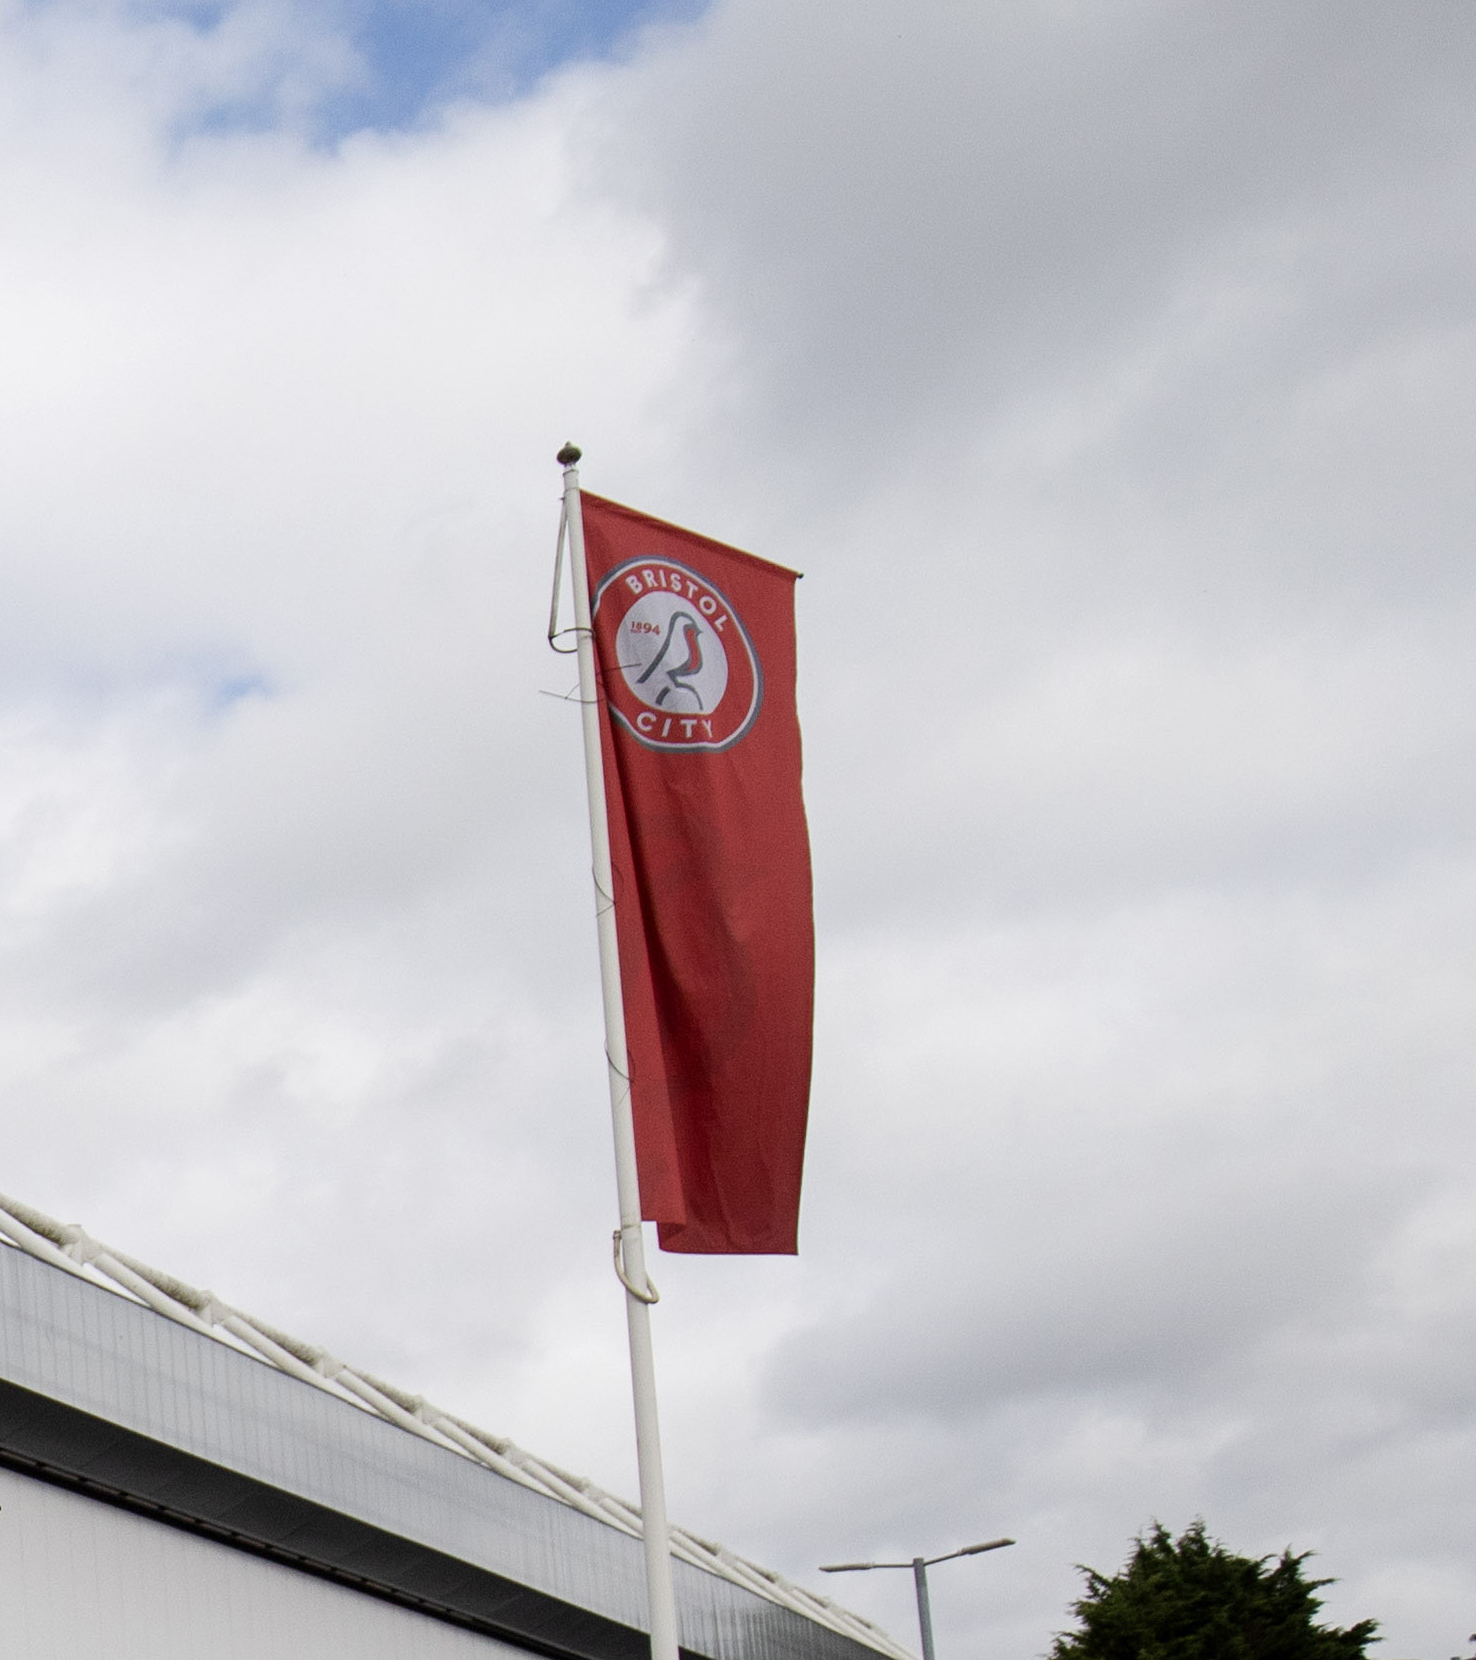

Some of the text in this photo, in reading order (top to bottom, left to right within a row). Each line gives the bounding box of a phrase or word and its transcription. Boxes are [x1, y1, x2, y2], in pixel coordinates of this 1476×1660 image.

[625, 569, 728, 632] BRISTOL
[630, 621, 661, 636] 1894
[636, 711, 713, 739] CITY
